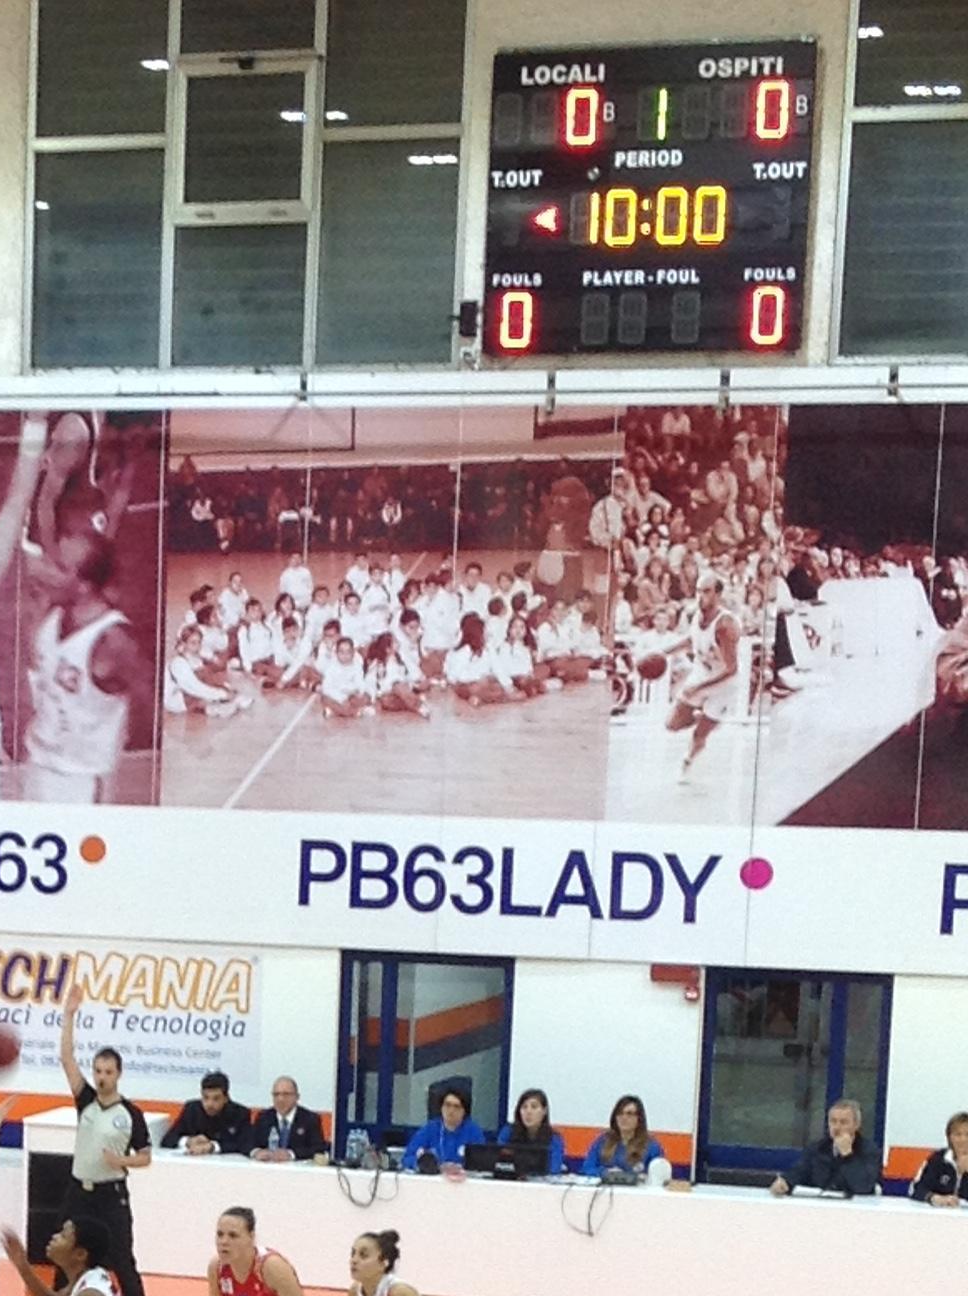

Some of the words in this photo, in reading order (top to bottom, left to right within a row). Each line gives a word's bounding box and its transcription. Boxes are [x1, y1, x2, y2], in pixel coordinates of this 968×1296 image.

[521, 64, 605, 85] LOCALI
[698, 56, 784, 78] OSPITI
[566, 88, 599, 146] 0
[657, 87, 668, 140] 1
[755, 80, 789, 140] 0
[614, 150, 683, 168] PERIOD
[753, 161, 807, 181] T.OUT
[491, 169, 543, 188] T.OUT
[589, 185, 727, 248] 10:00
[492, 273, 542, 287] FOULS
[744, 268, 796, 282] FOULS
[499, 291, 533, 349] 0
[750, 285, 785, 346] 0
[298, 839, 722, 924] PB63LADY
[109, 1007, 246, 1042] Tecnologia
